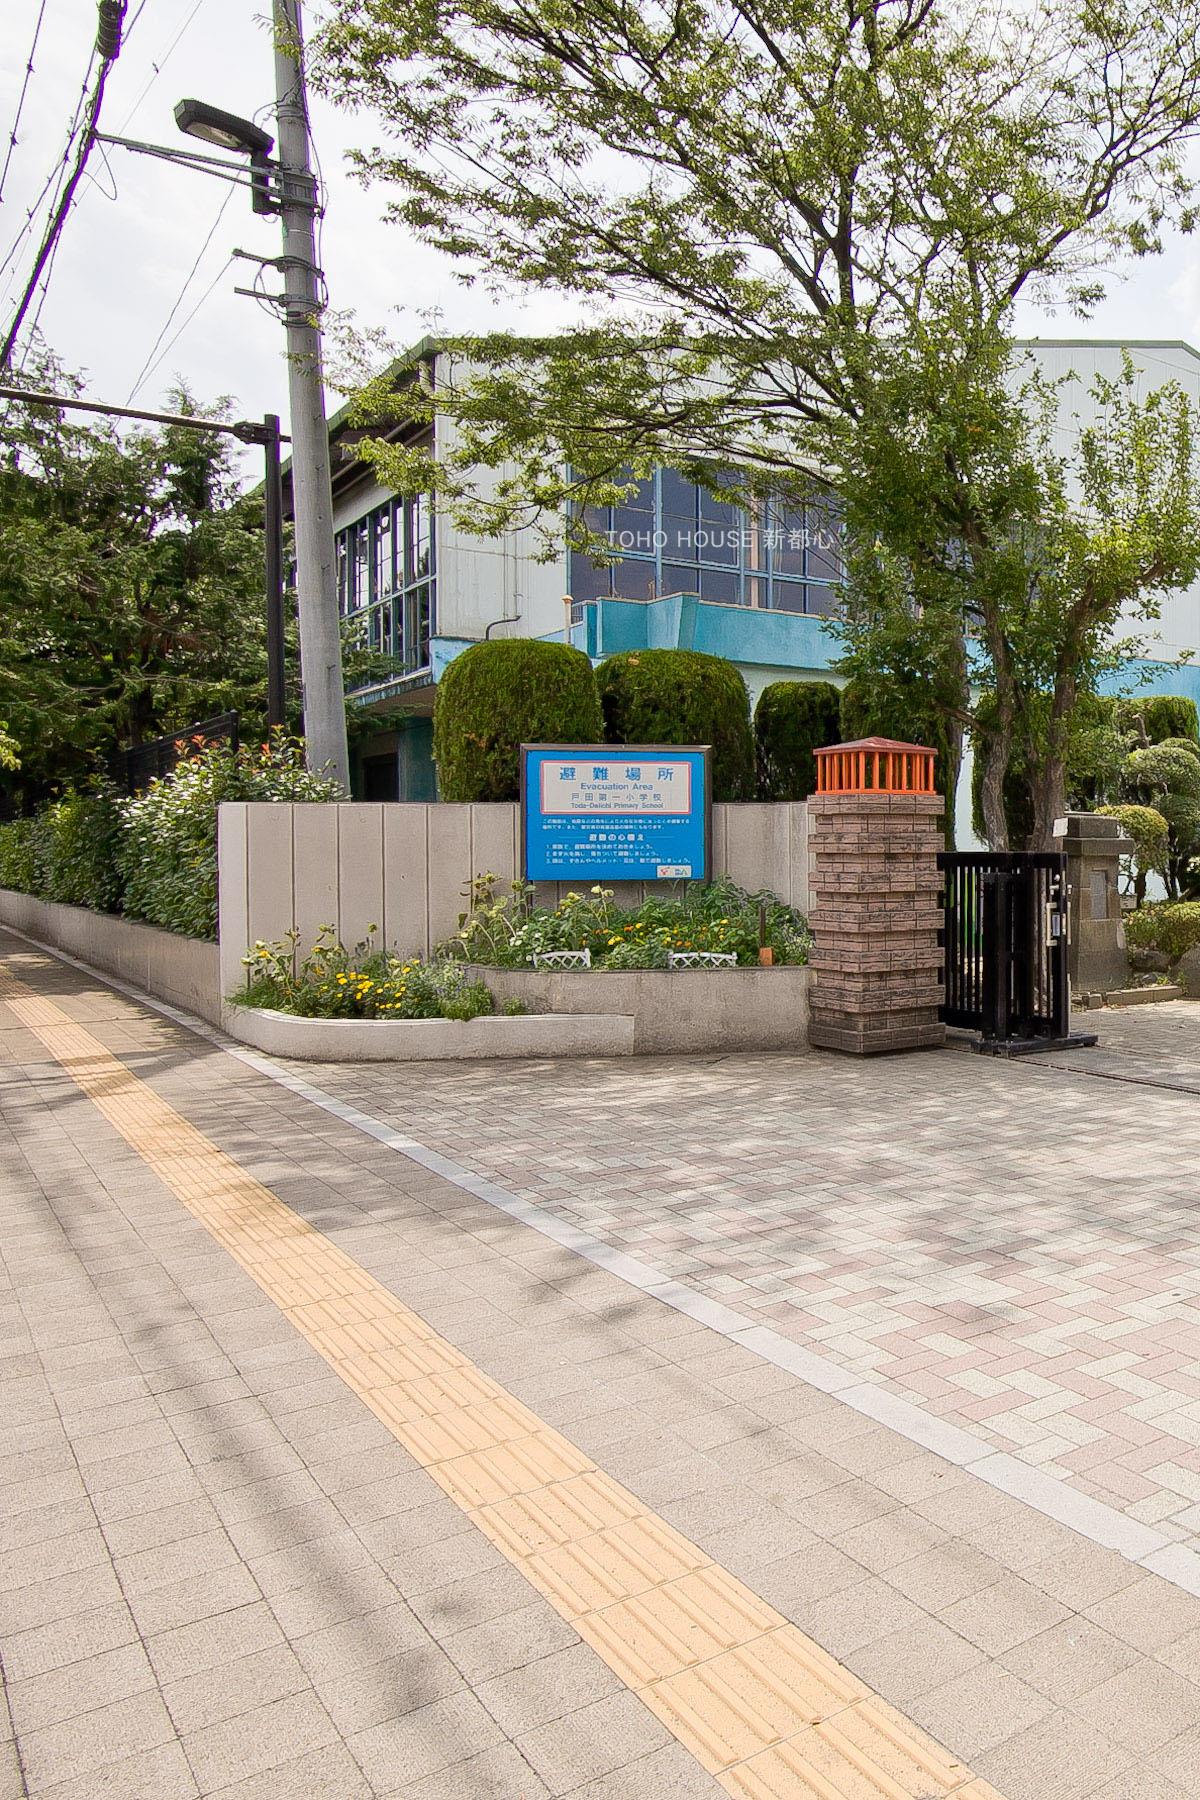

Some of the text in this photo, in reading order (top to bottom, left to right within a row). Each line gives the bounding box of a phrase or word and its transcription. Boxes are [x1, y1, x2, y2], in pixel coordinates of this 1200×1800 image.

[559, 766, 674, 781] 避難場所
[580, 782, 654, 791] Evacuation Area
[571, 793, 662, 802] 戸田第一小学校
[613, 802, 639, 810] Primary
